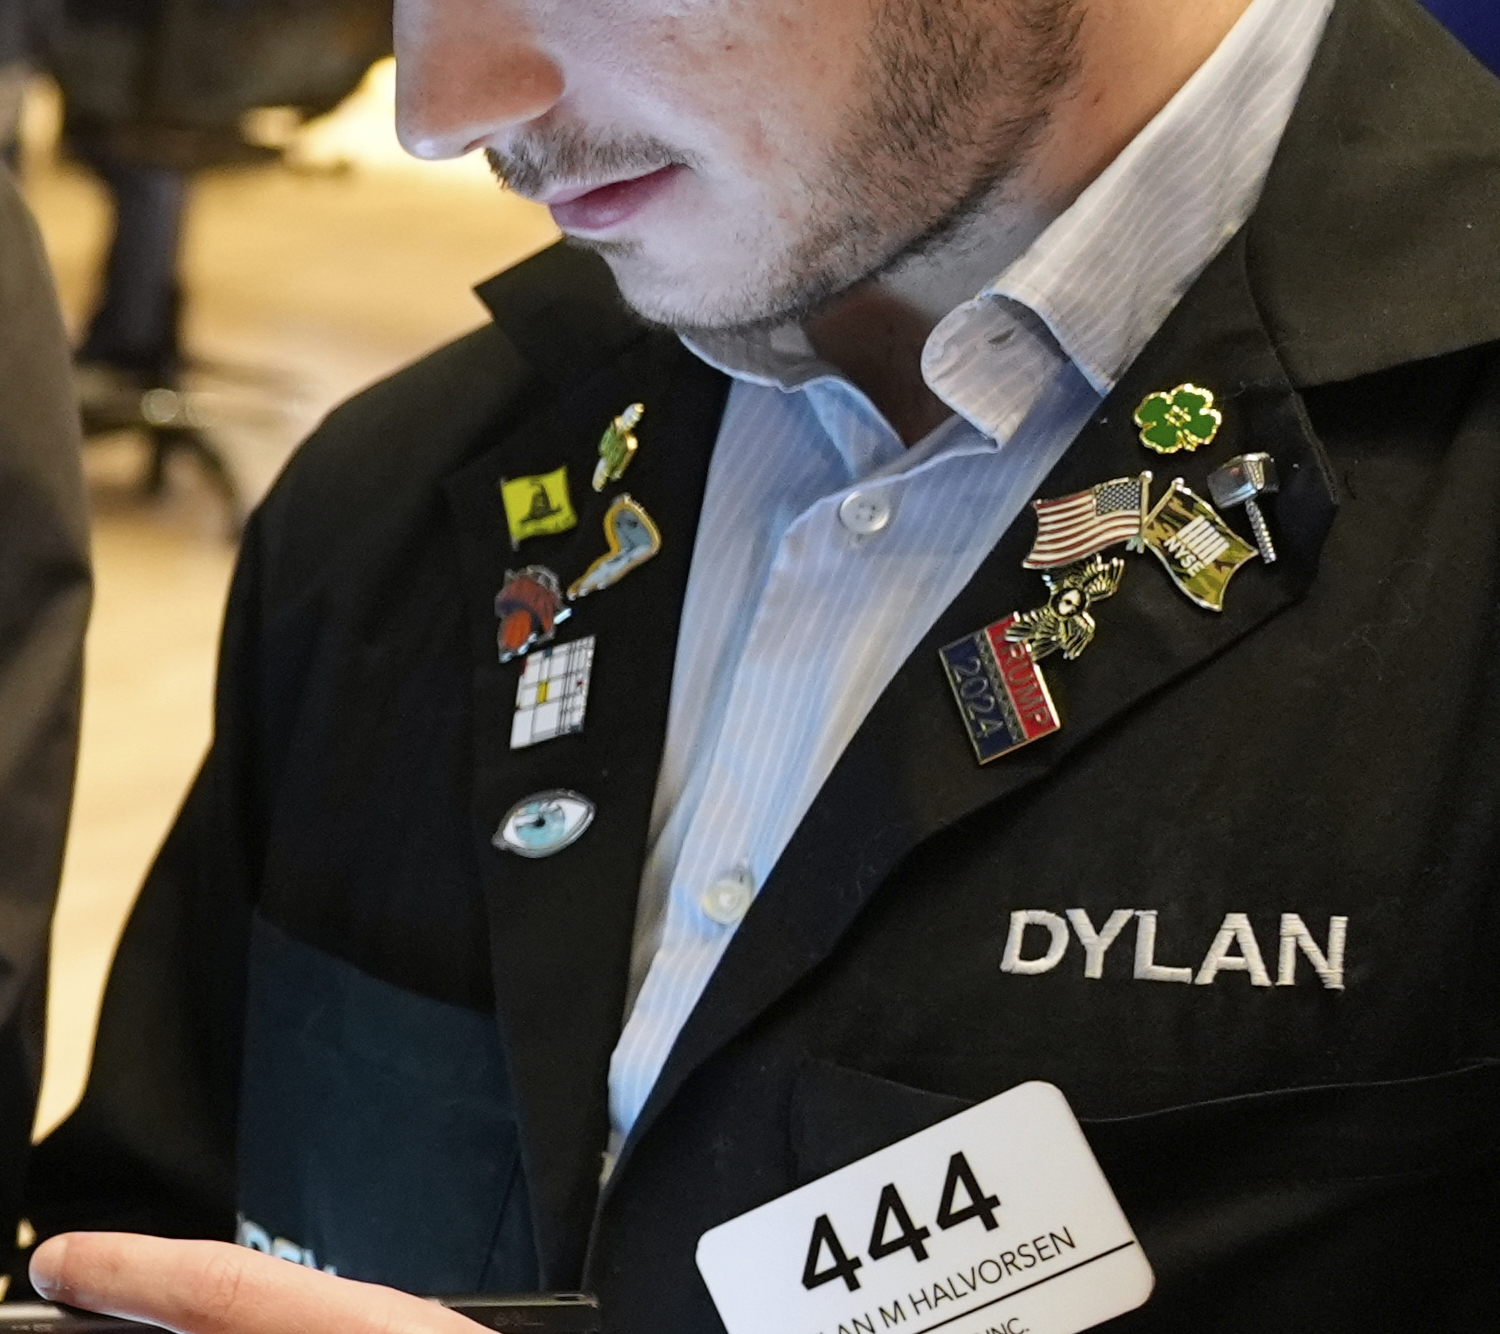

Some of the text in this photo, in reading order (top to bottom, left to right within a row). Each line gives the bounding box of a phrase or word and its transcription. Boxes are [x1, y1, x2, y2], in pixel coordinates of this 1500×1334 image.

[1163, 536, 1206, 577] NYSE
[954, 656, 1004, 739] 2024
[1000, 908, 1349, 990] DYLAN
[801, 1150, 1001, 1292] 444
[878, 1300, 907, 1329] M
[908, 1226, 1076, 1315] HALVORSEN
